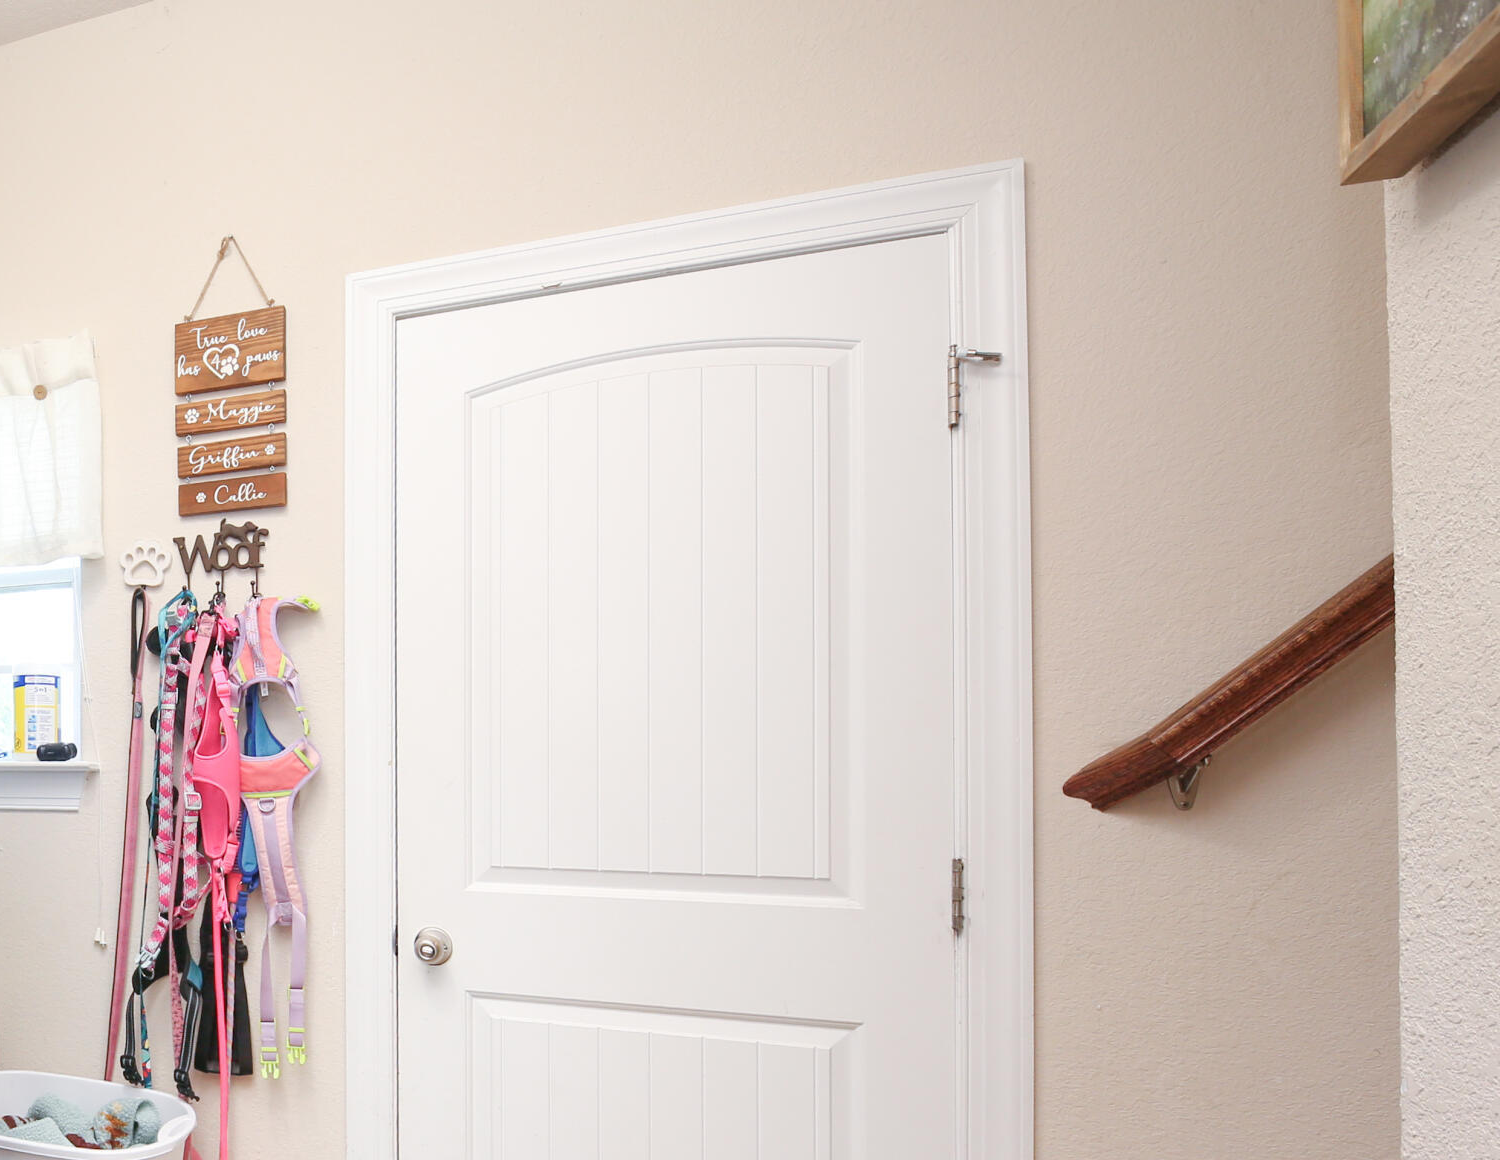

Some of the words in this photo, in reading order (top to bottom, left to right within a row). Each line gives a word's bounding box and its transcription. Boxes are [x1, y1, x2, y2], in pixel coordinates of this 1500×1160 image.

[189, 327, 228, 350] True
[237, 318, 268, 342] love
[177, 355, 201, 378] has
[211, 354, 221, 370] 4
[242, 348, 280, 377] paws
[203, 398, 276, 424] Maggie
[189, 445, 261, 474] Griffin
[213, 483, 267, 505] Callie
[172, 528, 270, 574] Woof
